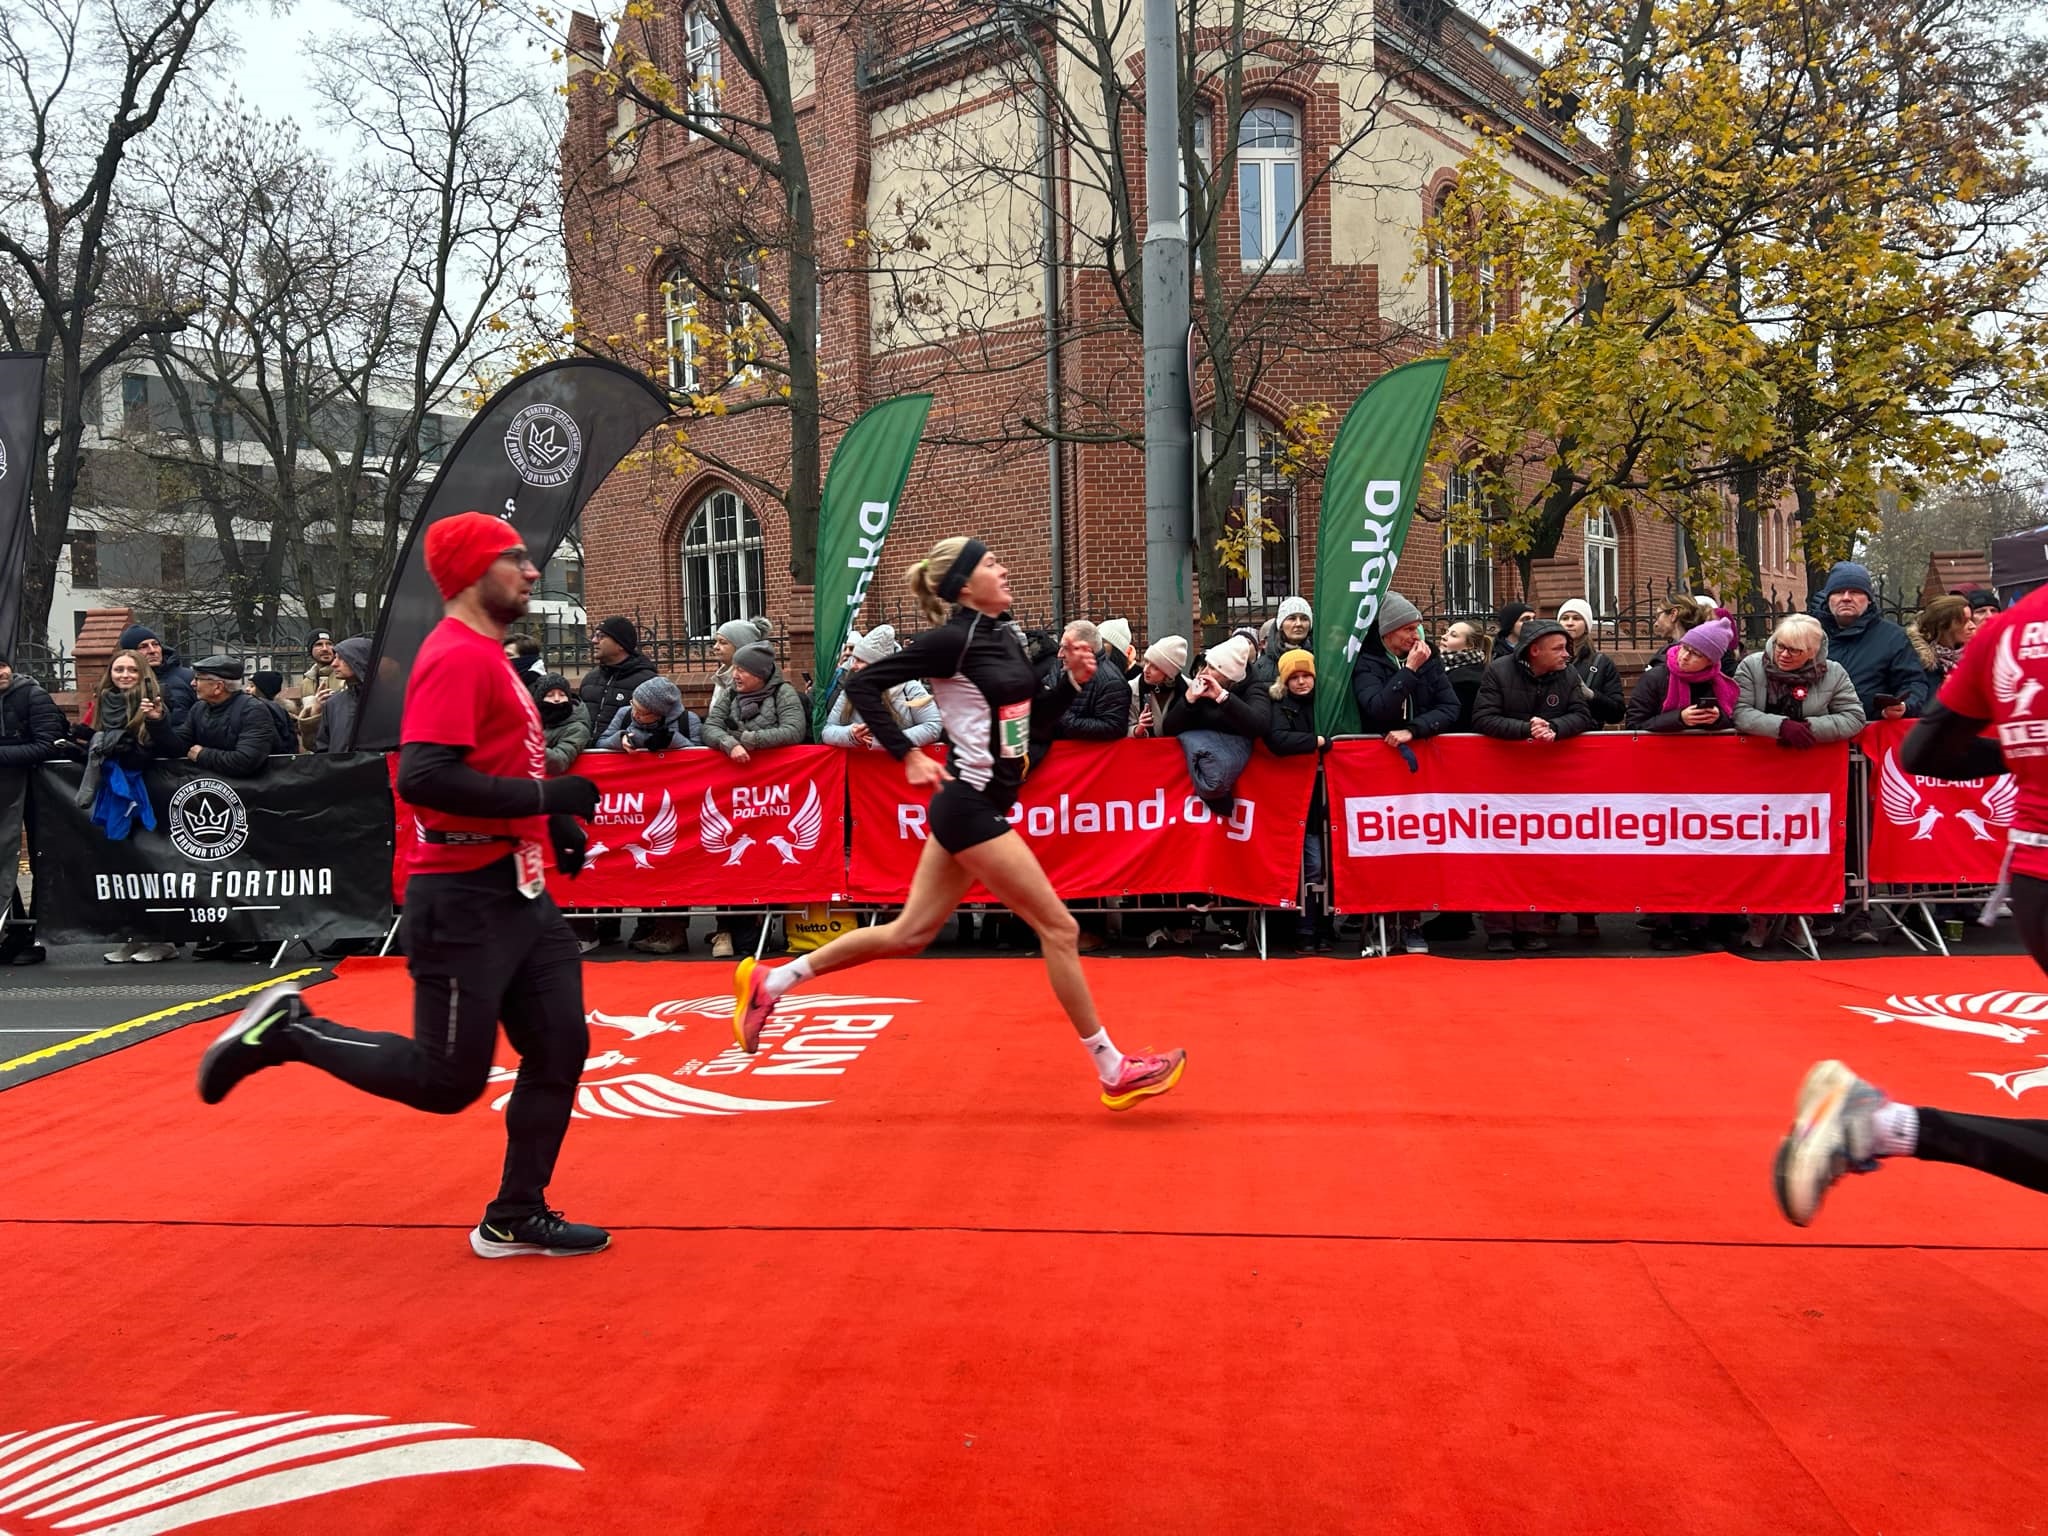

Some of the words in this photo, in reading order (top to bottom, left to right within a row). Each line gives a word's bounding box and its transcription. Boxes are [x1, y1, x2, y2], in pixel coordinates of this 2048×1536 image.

[732, 783, 790, 808] RUN
[592, 813, 645, 826] OLAND
[732, 804, 791, 820] POLAND
[1356, 804, 1820, 847] BiegNiepodleglosci.pl
[95, 872, 197, 900] BROWAR
[210, 868, 332, 898] FORTUNA
[189, 907, 228, 924] 1889
[795, 922, 828, 933] Netto
[751, 1014, 895, 1075] RUN
